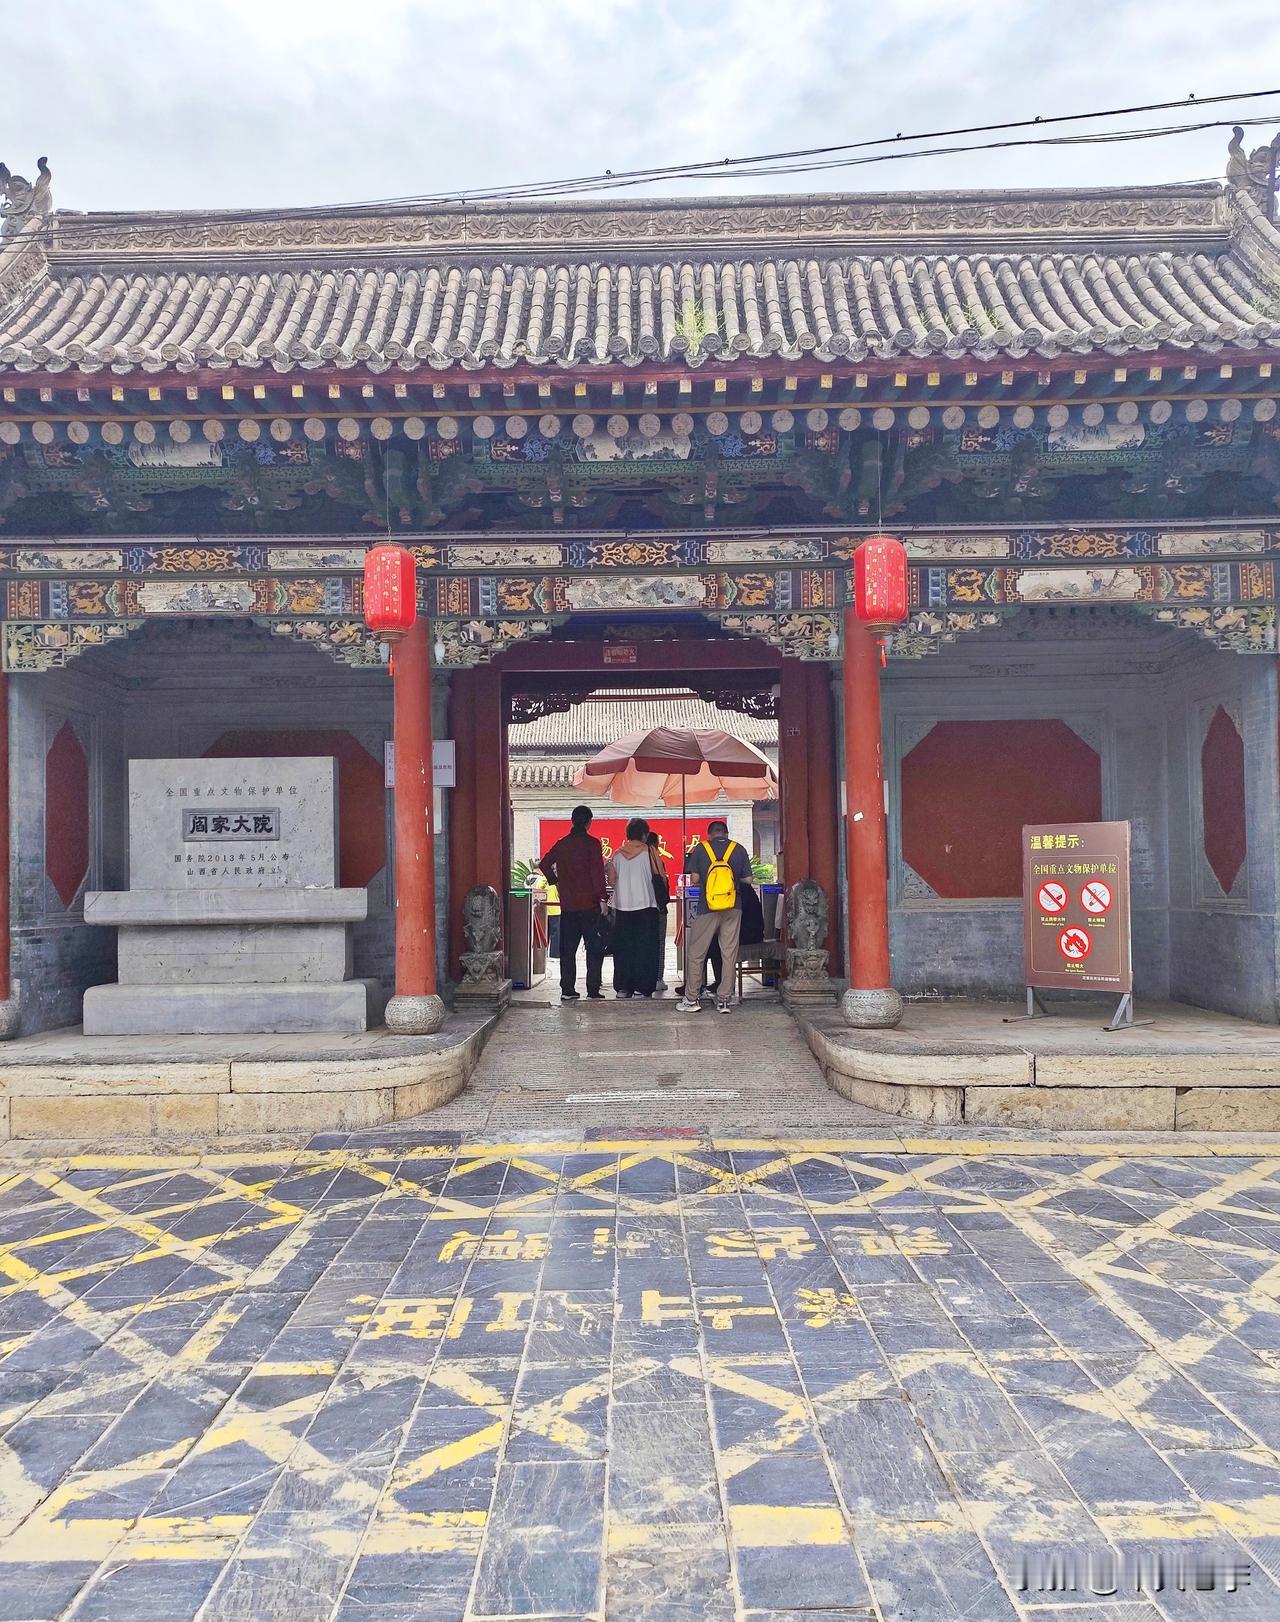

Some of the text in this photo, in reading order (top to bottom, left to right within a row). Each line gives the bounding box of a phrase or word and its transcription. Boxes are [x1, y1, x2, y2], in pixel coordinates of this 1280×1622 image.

[165, 785, 298, 798] 全国重点文物保护单位
[189, 815, 273, 834] 阎家大院
[174, 853, 290, 863] 国务院2013年5月公布
[1033, 863, 1117, 875] 全国重点文物保护单位
